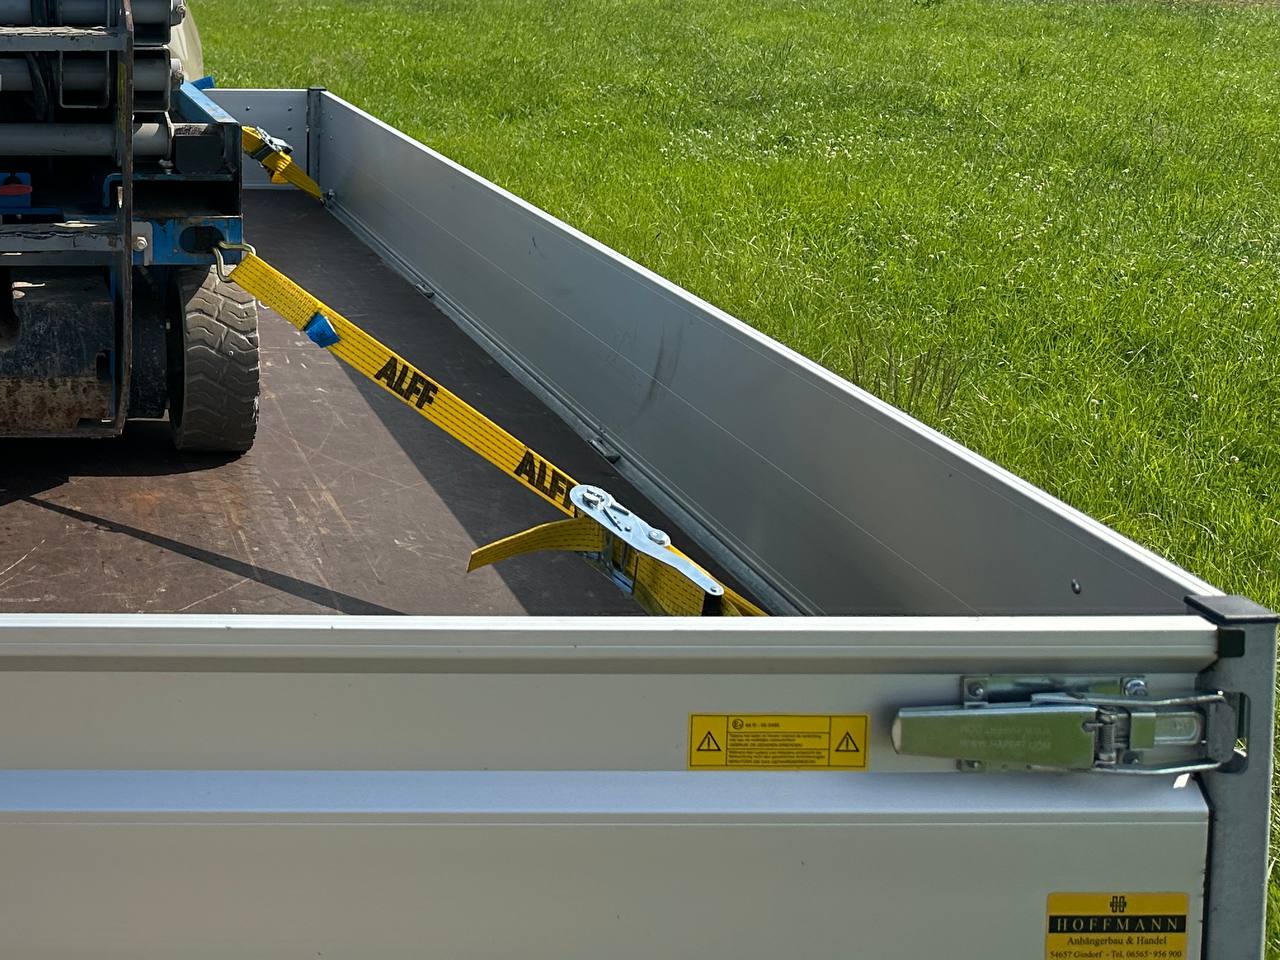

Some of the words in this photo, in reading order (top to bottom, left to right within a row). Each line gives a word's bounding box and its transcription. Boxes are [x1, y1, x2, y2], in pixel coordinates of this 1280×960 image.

[374, 356, 438, 409] ALFF
[1057, 918, 1179, 931] HOFFMANN
[1126, 937, 1134, 945] &
[1137, 936, 1167, 945] Handel
